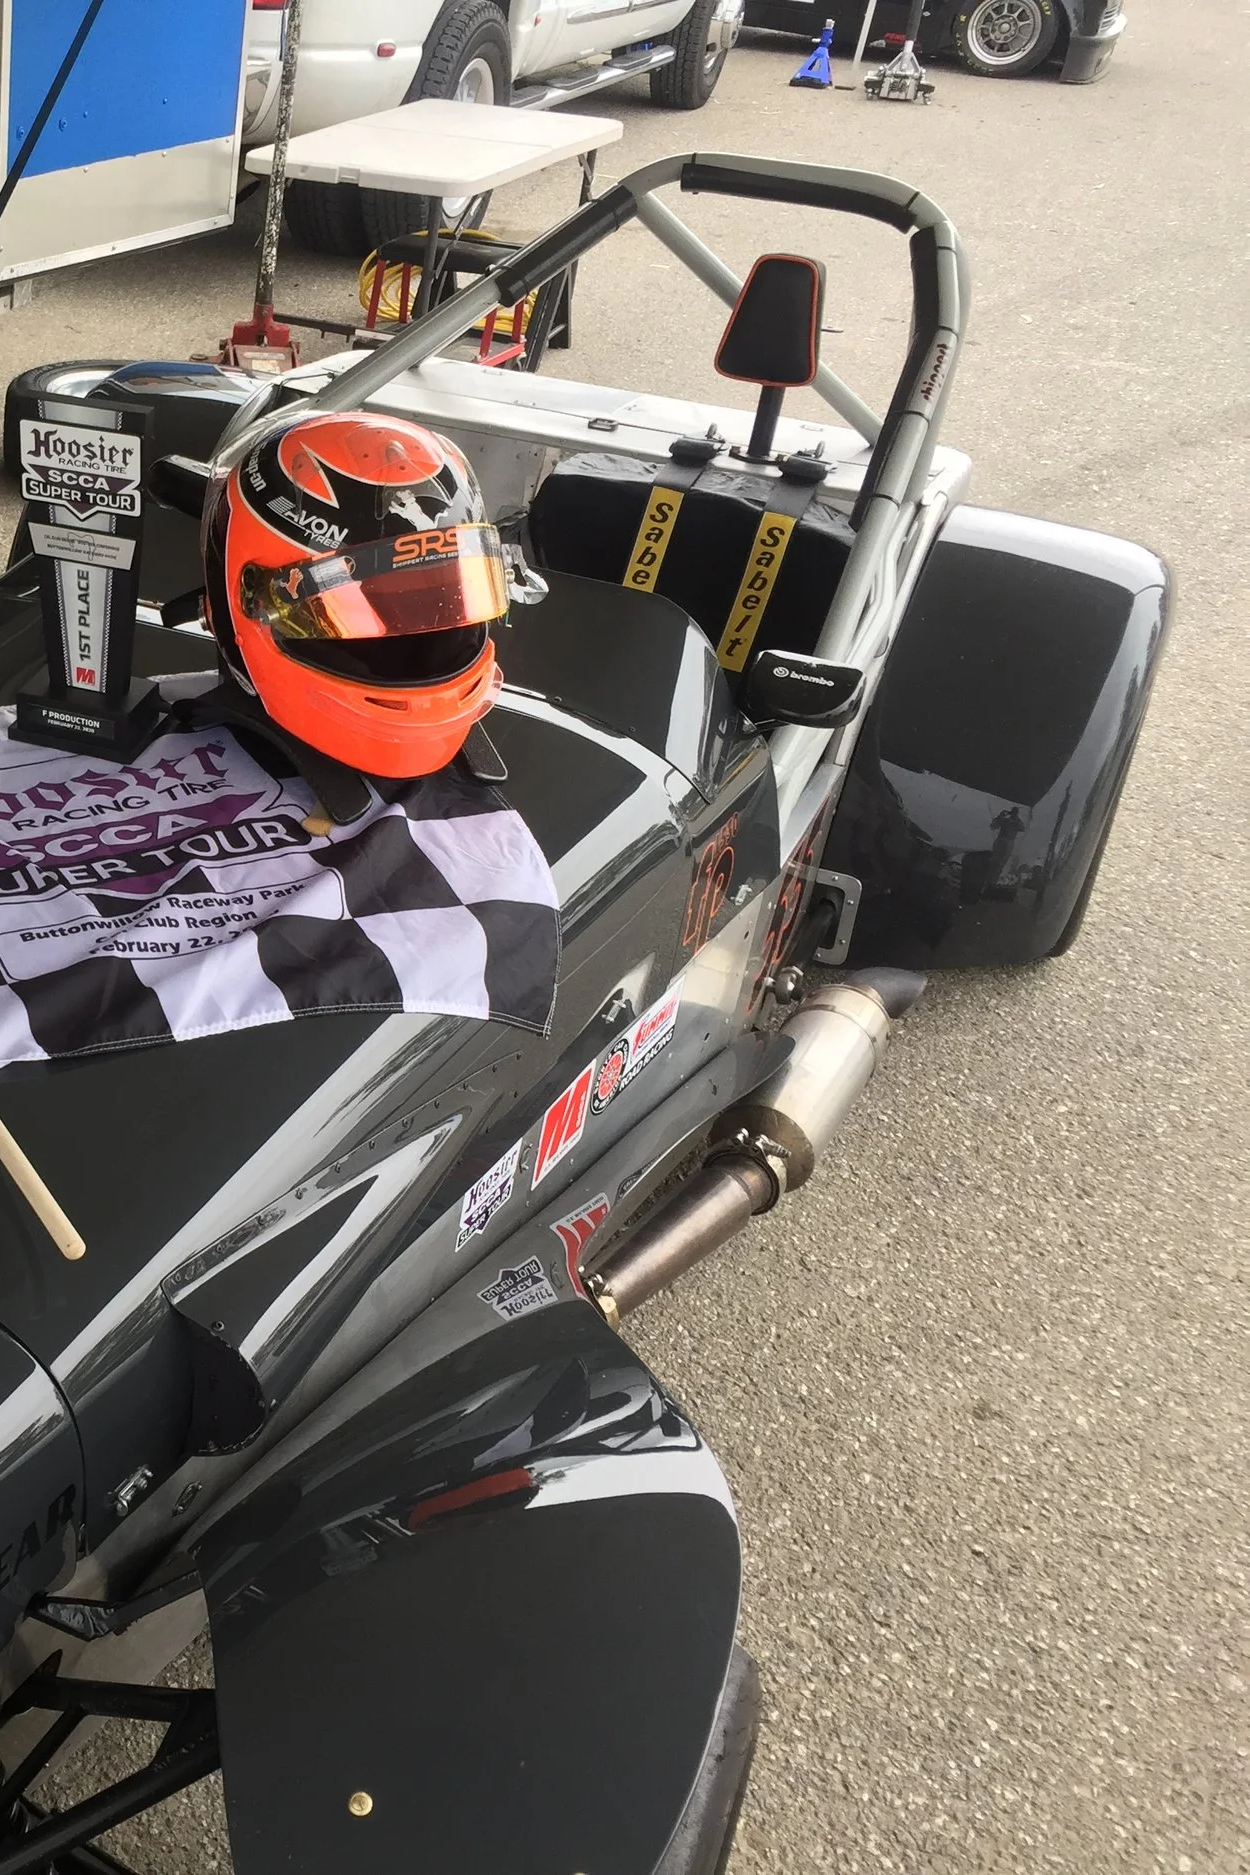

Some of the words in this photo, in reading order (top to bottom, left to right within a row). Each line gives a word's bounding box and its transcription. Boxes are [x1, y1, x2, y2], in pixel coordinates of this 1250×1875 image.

[27, 428, 135, 468] Hoosier
[48, 469, 111, 492] SCCA
[58, 457, 101, 471] RACING
[104, 464, 127, 475] TIRE
[29, 480, 82, 502] SUPER
[85, 492, 132, 510] TOUR
[283, 508, 349, 542] AVON
[303, 530, 342, 549] TYRES
[76, 569, 91, 628] PLACE
[724, 526, 786, 657] Sabelt
[78, 630, 91, 662] 1ST
[789, 670, 835, 688] brembo
[42, 709, 48, 717] F
[48, 710, 100, 729] PRODUCTION
[12, 796, 151, 831] RACING
[158, 778, 234, 801] TIRE
[1, 813, 208, 863] SCCA
[141, 820, 299, 867] TOUR
[166, 893, 255, 911] Raceway
[259, 882, 307, 900] Park
[184, 909, 258, 929] Region
[89, 938, 181, 955] ebruary
[465, 1150, 518, 1214] Hoosier
